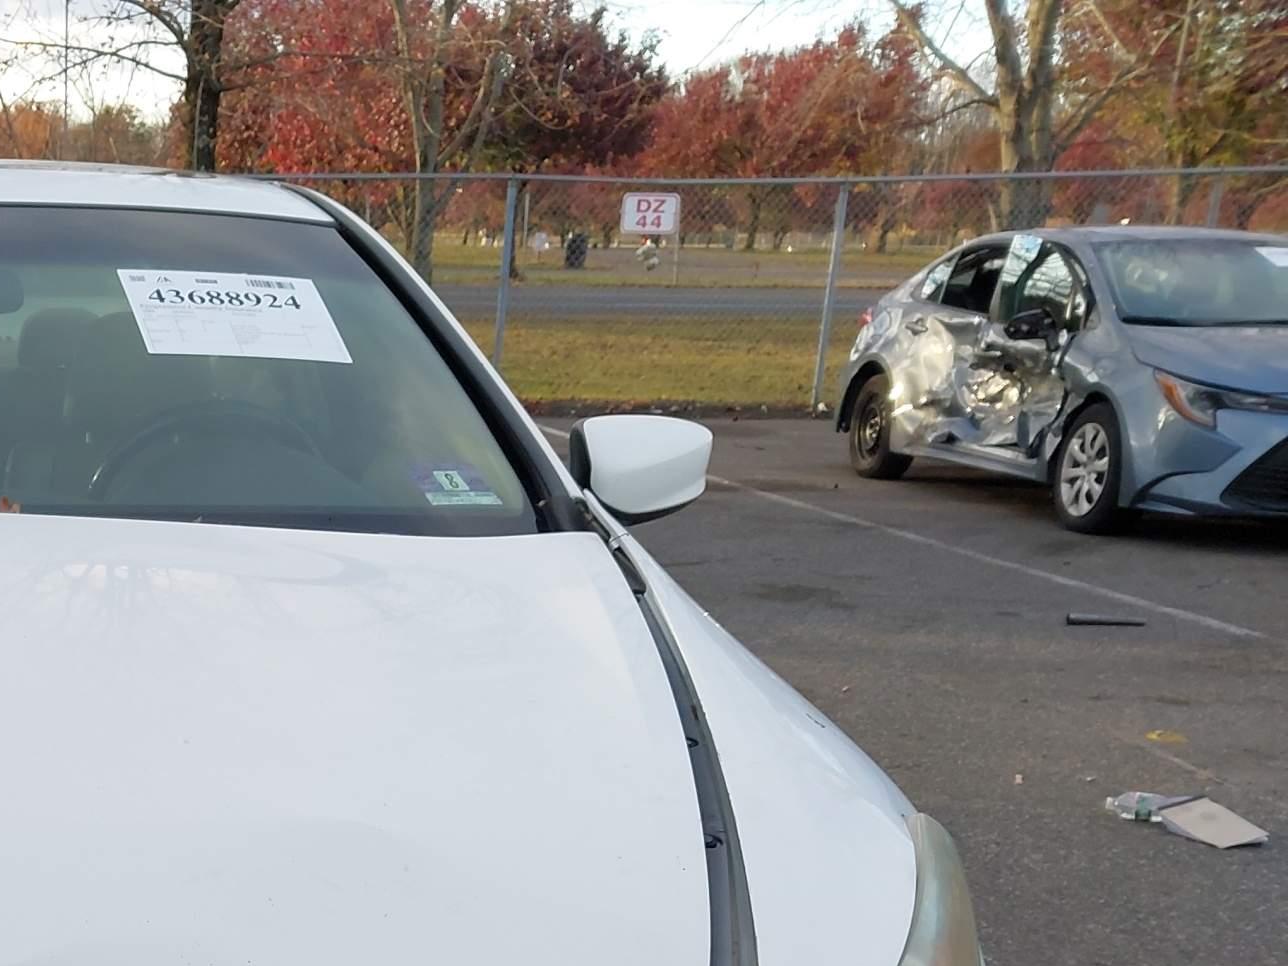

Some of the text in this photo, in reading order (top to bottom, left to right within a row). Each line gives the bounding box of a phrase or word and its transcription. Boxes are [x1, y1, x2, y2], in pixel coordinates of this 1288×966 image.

[636, 198, 667, 214] DZ
[635, 215, 662, 228] 44
[148, 287, 302, 311] 43688924
